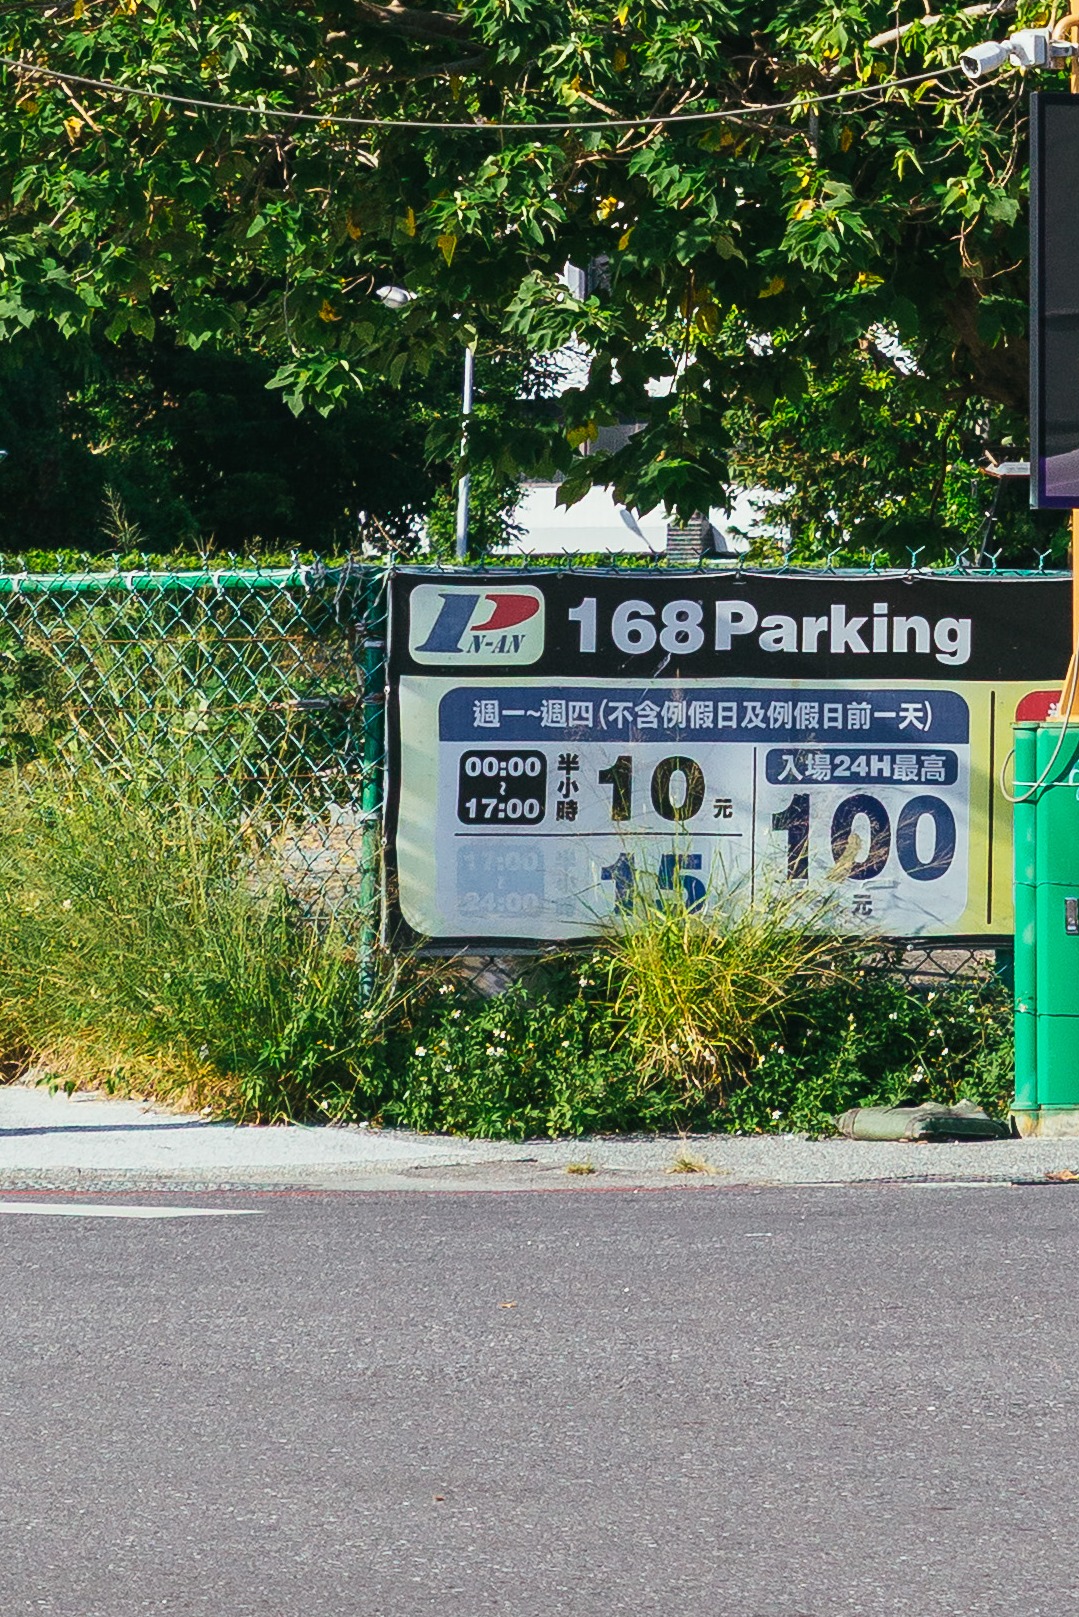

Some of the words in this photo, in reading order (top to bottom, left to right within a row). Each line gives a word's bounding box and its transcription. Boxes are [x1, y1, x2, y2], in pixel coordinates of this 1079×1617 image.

[465, 756, 541, 777] 00:00
[777, 754, 946, 782] 入場24H最高
[555, 753, 580, 822] 半小時
[598, 755, 706, 822] 10
[464, 798, 540, 819] 17:00
[771, 793, 957, 881] 100
[851, 894, 873, 916] 元
